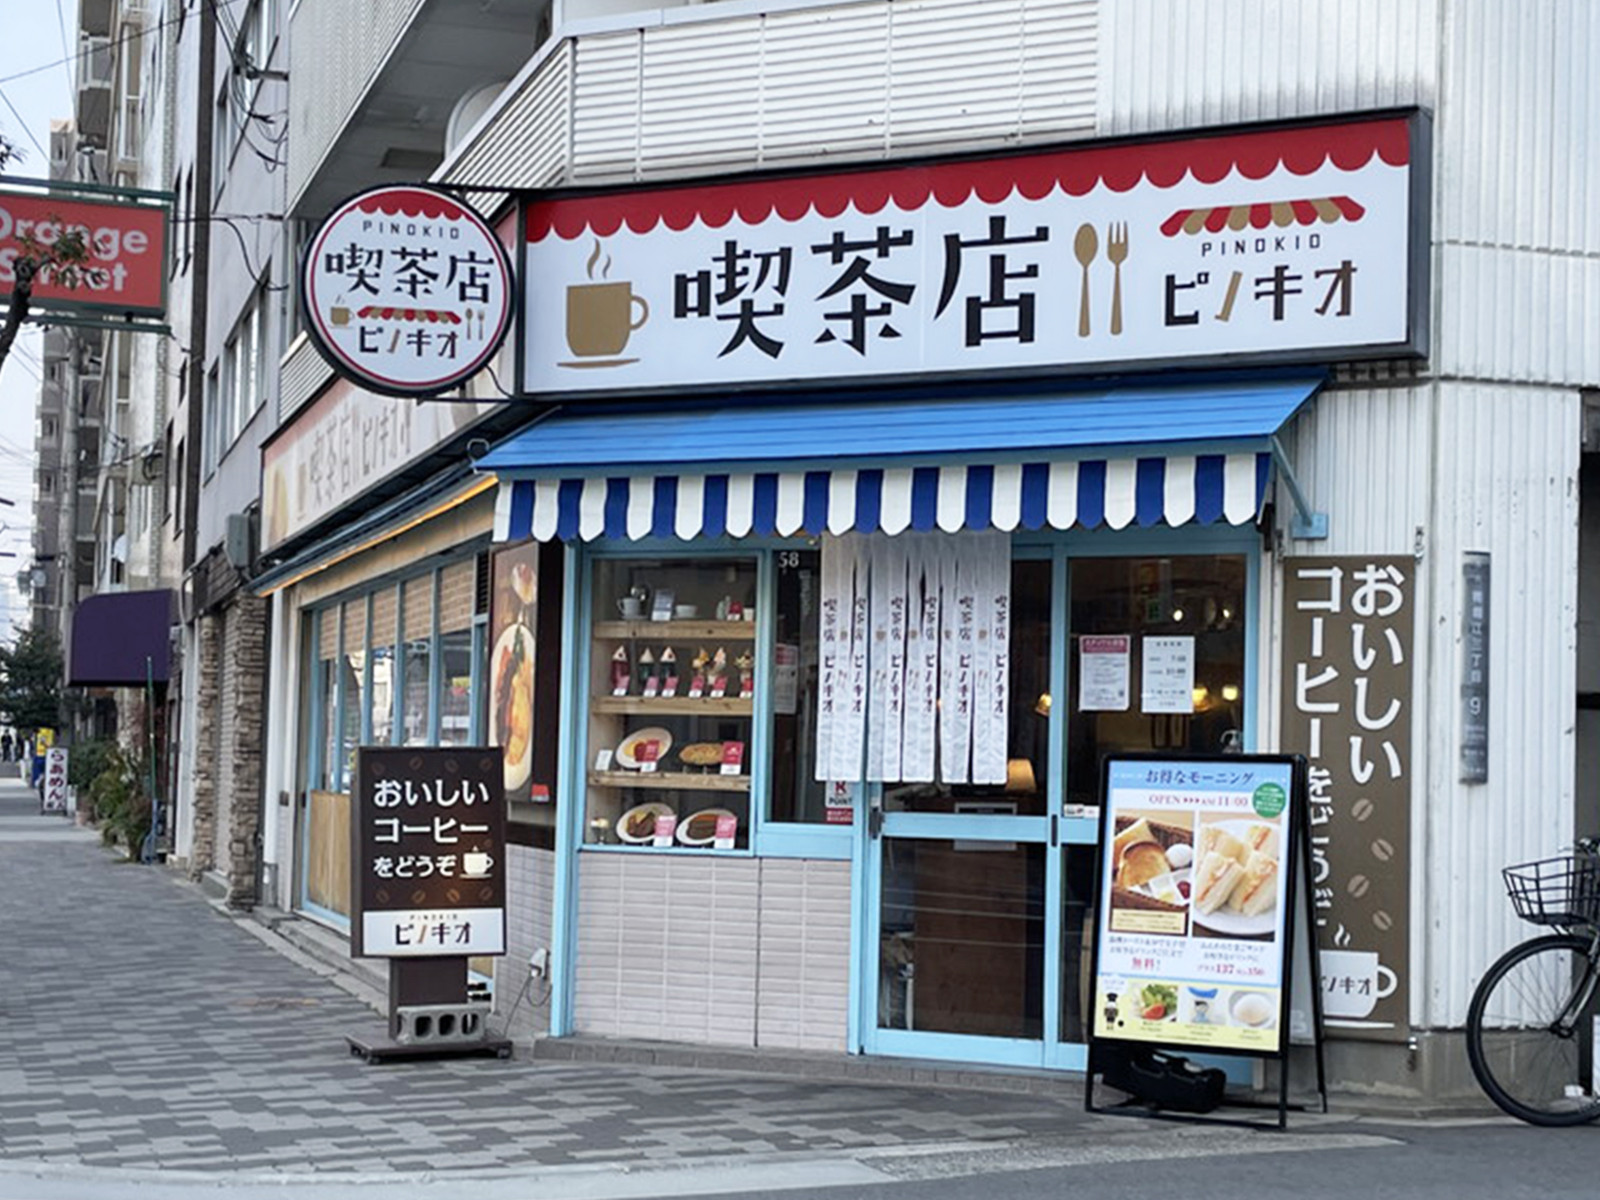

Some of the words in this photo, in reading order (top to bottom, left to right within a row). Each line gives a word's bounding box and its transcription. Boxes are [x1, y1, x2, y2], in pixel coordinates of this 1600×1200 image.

[363, 220, 459, 239] PINOKIO
[1202, 234, 1321, 257] PINOKIO
[325, 242, 494, 303] 喫茶店
[674, 215, 1049, 359] 喫茶店
[1164, 260, 1357, 327] ピノキオ
[360, 326, 458, 358] ピノキオ
[779, 552, 799, 568] 58
[1350, 564, 1405, 784] おいしい
[1470, 696, 1480, 715] 9
[1145, 769, 1255, 785] お得なモーニング
[373, 779, 489, 807] おいしい
[1149, 794, 1180, 805] OPEN
[374, 817, 489, 843] コーヒー
[373, 856, 457, 877] をどうぞ
[395, 921, 471, 945] ピノキオ
